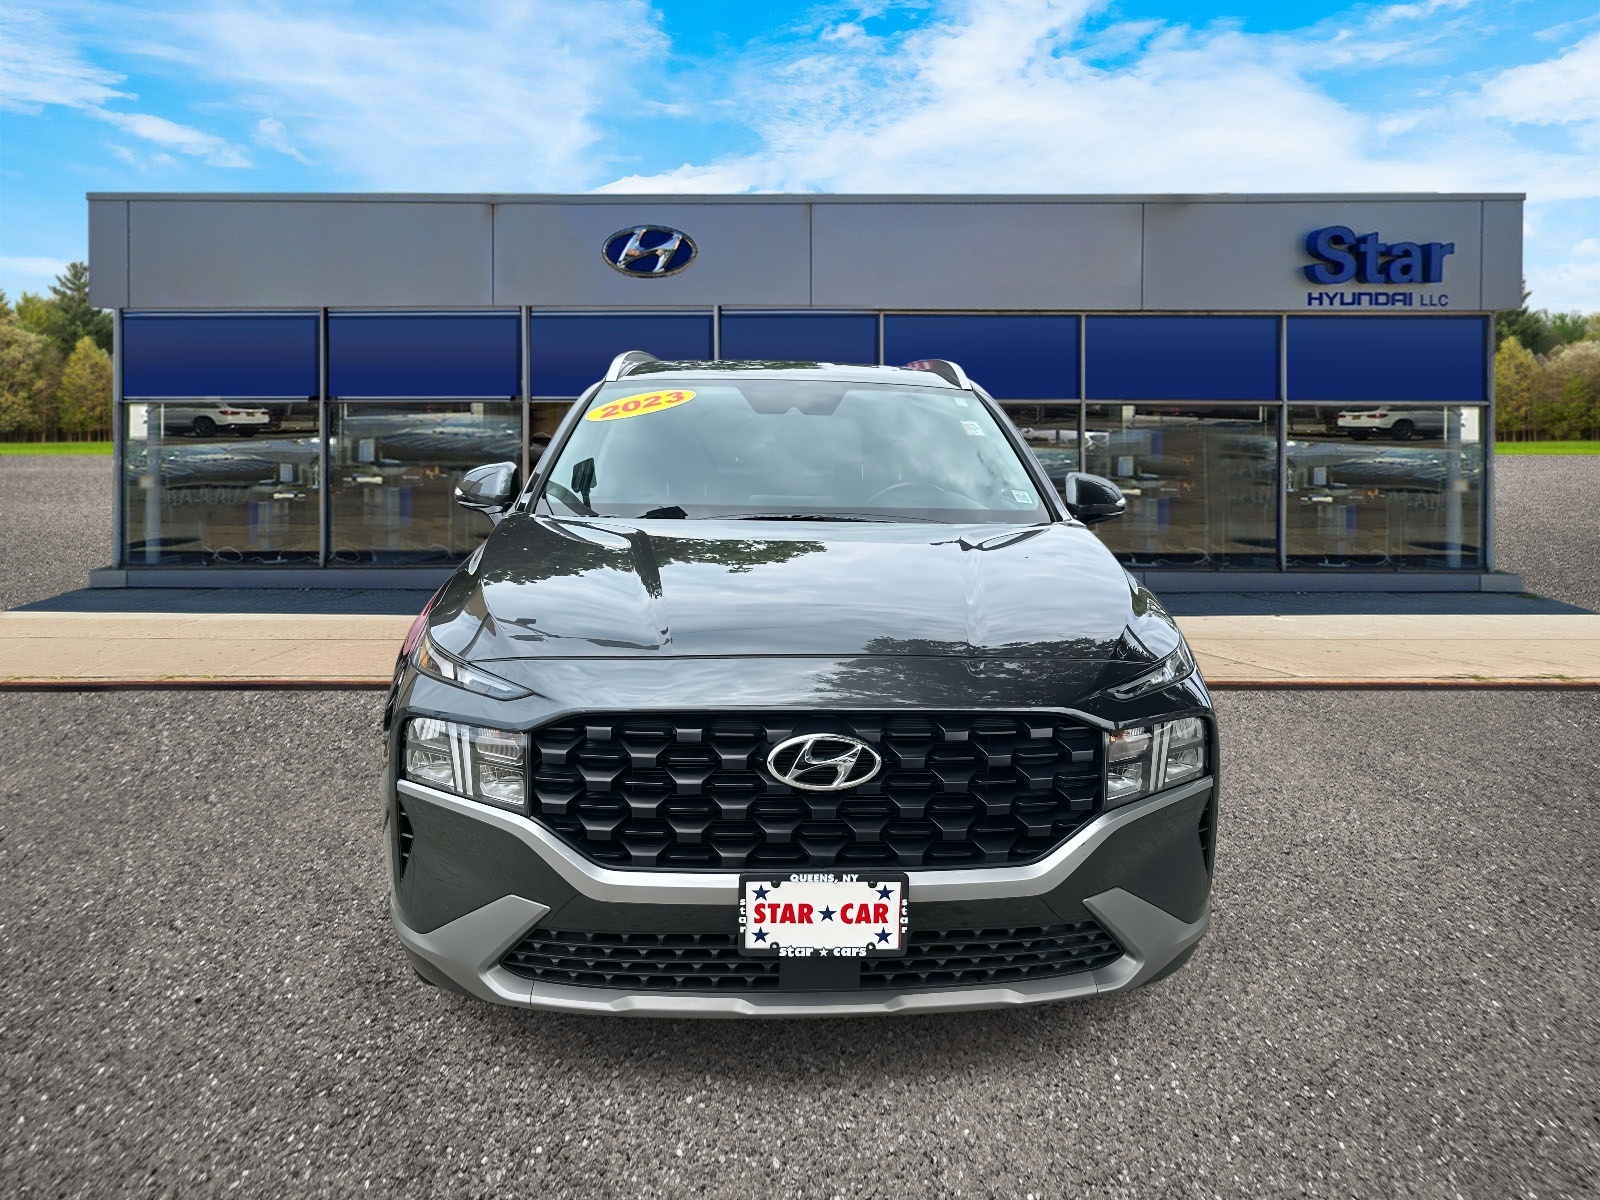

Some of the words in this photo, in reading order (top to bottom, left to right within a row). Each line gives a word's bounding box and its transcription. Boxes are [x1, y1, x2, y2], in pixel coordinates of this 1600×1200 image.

[1303, 225, 1454, 284] Star
[1307, 292, 1413, 306] HYUNDAI
[1420, 294, 1449, 306] LLC
[600, 391, 685, 418] 2023
[790, 873, 838, 884] QUEENS,
[842, 874, 859, 882] NY
[754, 903, 814, 924] STAR
[840, 903, 889, 924] CAR
[779, 945, 814, 957] star
[833, 946, 867, 957] cars
